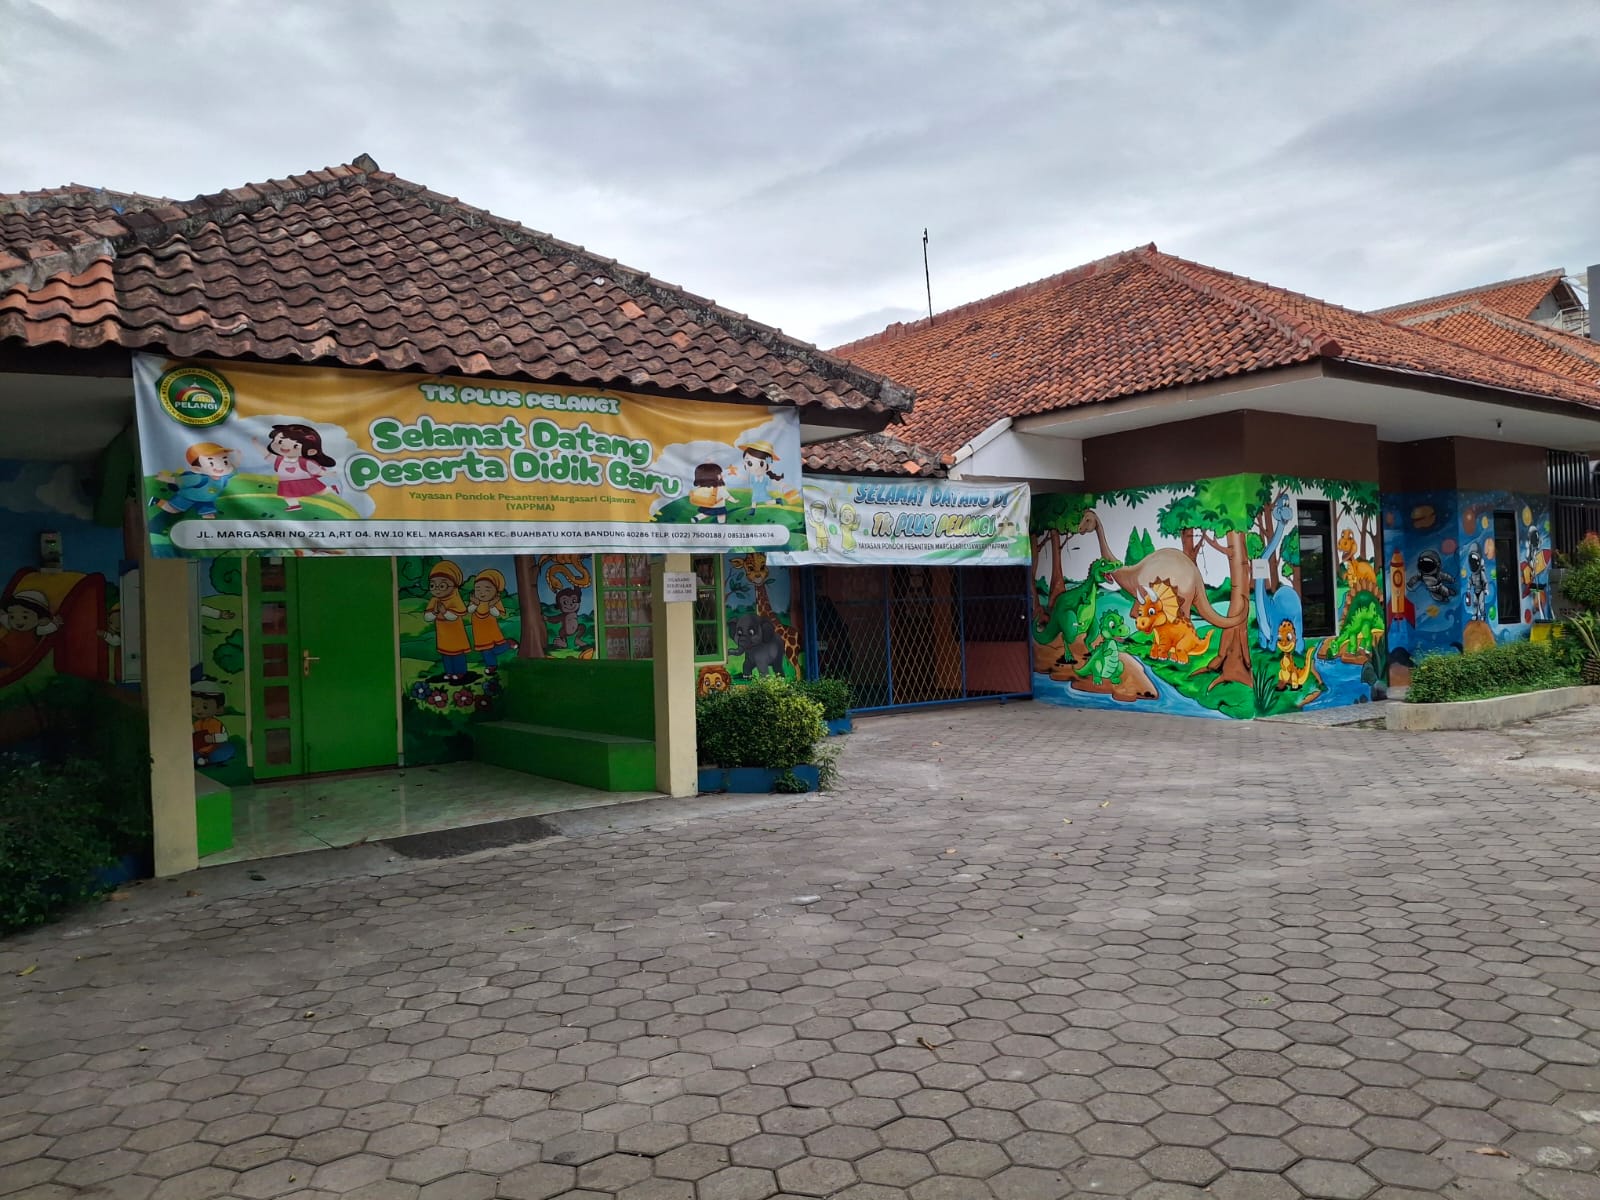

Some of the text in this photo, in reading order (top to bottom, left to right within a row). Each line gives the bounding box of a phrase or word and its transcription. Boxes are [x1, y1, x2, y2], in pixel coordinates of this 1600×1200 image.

[175, 401, 218, 411] PELANGI
[419, 384, 621, 416] TK PLUS PELANGI
[372, 418, 651, 466] Selamat Datang
[349, 451, 680, 495] Peserta Didik Baru
[408, 491, 636, 505] Yayasan Pondok Pesantren Margasari Cijawura
[506, 503, 555, 512] (YAPPMA)
[854, 484, 928, 506] SELAMAT
[930, 486, 990, 508] DATANG
[196, 531, 213, 539] JL.
[216, 531, 286, 539] MARGASARI
[289, 531, 306, 539] NO
[308, 531, 325, 539] 221
[406, 531, 426, 539] KEL.
[428, 531, 486, 539] MARGASARI
[488, 531, 508, 539] KEC.
[510, 531, 559, 539] BUAHBATU
[561, 531, 582, 539] KOTA
[584, 530, 625, 539] BANDUNG
[626, 531, 649, 539] 40286
[671, 532, 690, 541] (022)
[692, 532, 722, 540] 7500188
[872, 512, 996, 538] TK PLUS PELANGI
